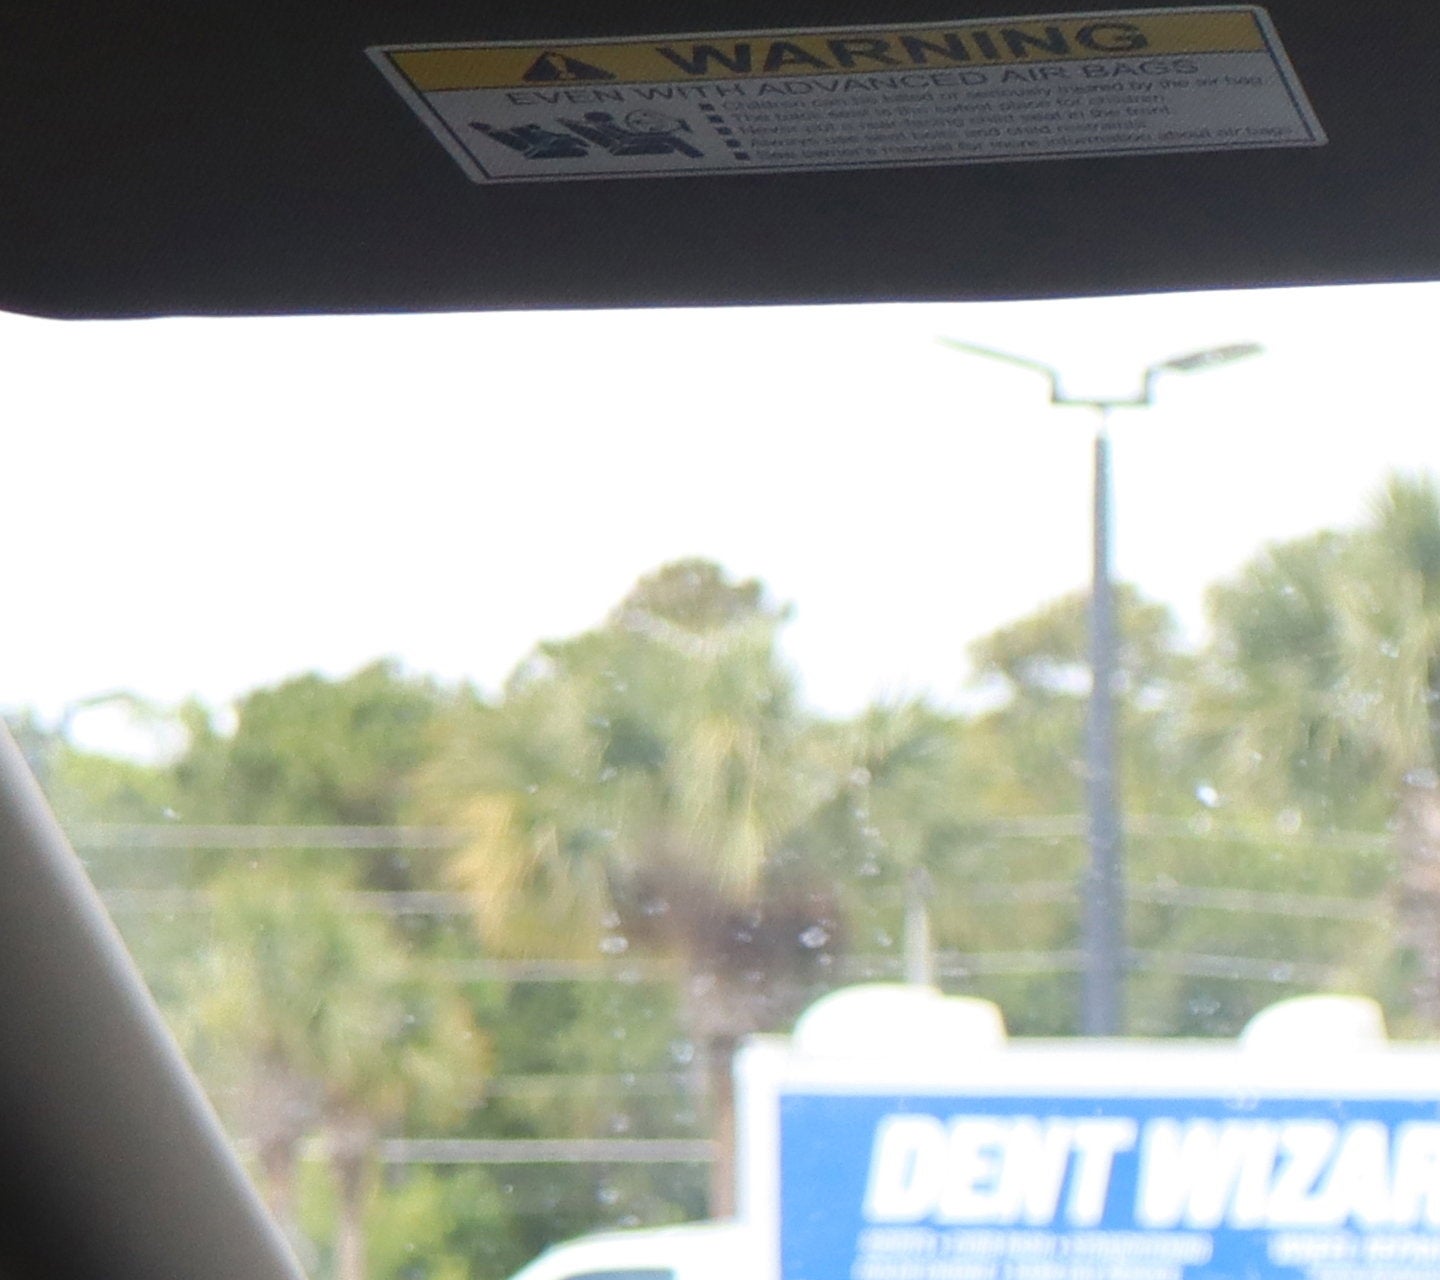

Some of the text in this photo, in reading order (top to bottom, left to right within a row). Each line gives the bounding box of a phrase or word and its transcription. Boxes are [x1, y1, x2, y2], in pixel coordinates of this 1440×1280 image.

[656, 20, 1149, 75] WARNING
[507, 88, 620, 106] EVEN
[633, 78, 742, 101] WITH
[757, 70, 987, 99] ADVANCED
[1001, 64, 1067, 83] AIR
[1082, 58, 1199, 79] BAGS
[864, 1112, 1138, 1228] DENT
